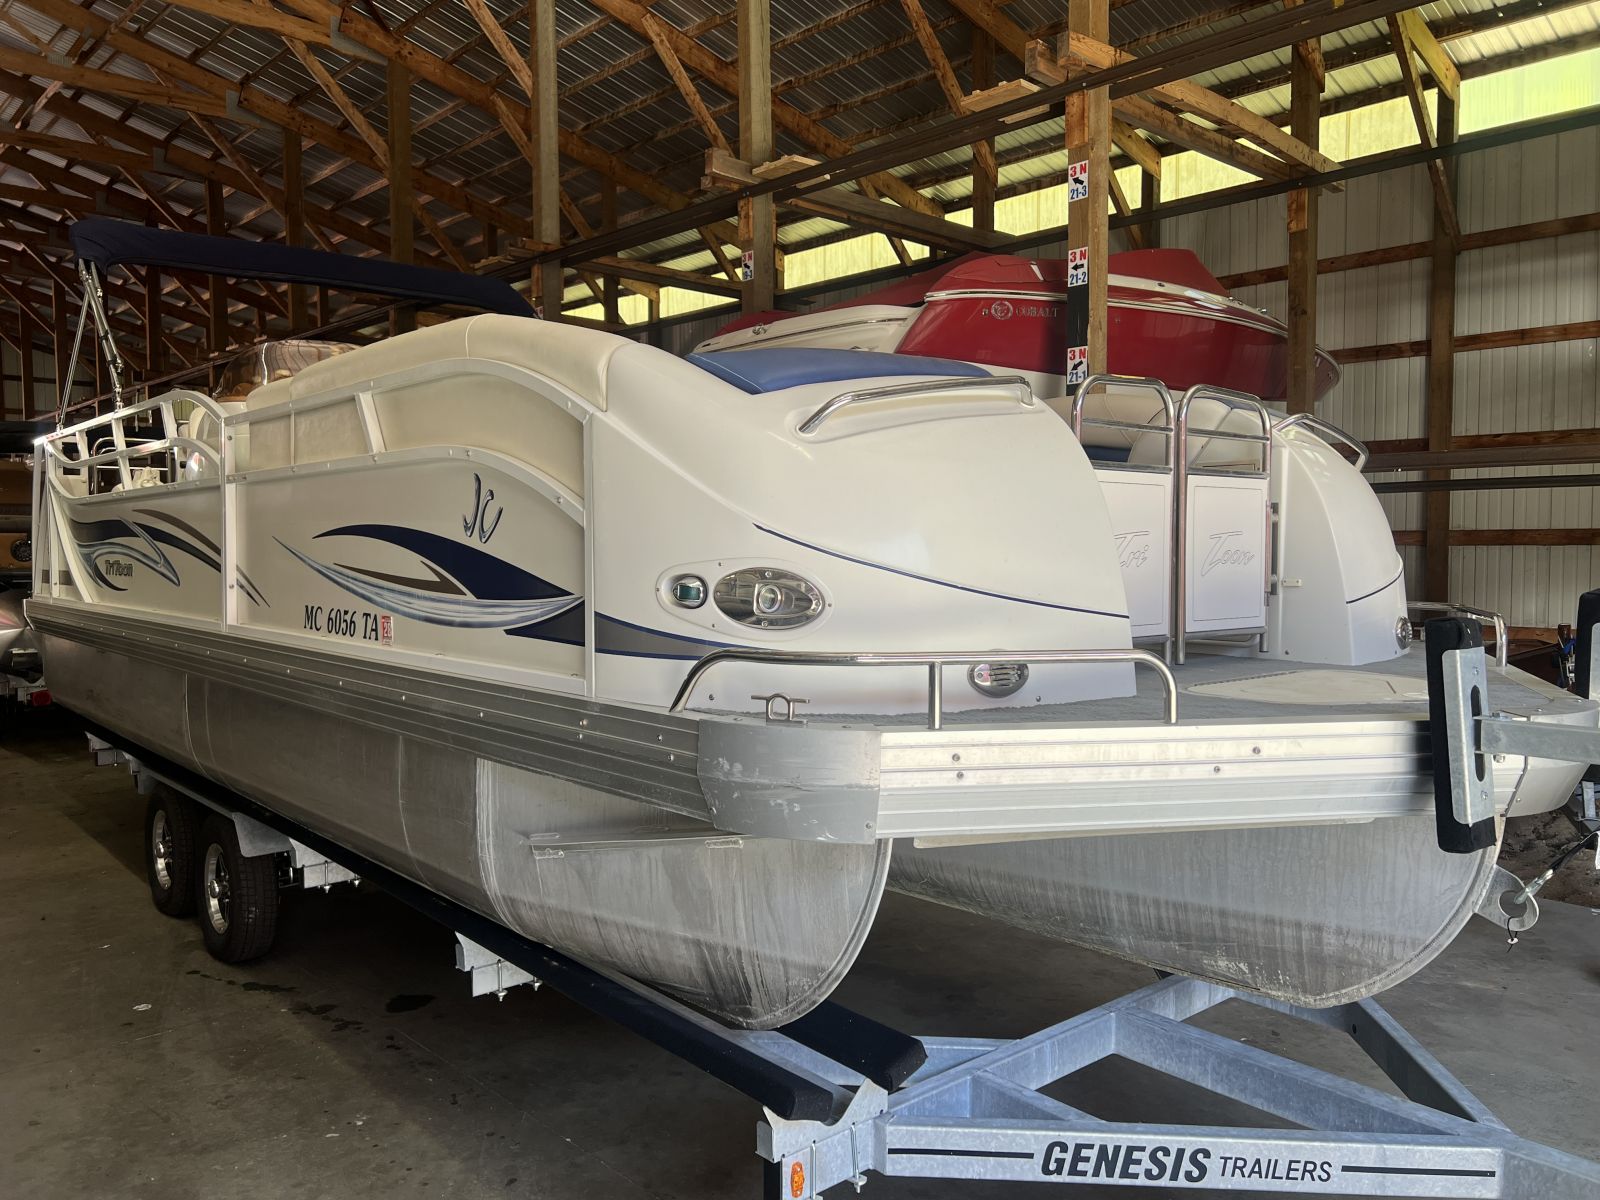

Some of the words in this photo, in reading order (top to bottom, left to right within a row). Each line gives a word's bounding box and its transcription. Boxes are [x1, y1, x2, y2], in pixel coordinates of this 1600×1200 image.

[1070, 165, 1077, 178] 3
[1080, 162, 1087, 175] N
[1070, 185, 1087, 200] 21-3
[1070, 251, 1077, 263] 3
[1079, 249, 1087, 261] N
[1070, 271, 1087, 286] 21-2
[1069, 349, 1076, 361] 3
[1079, 347, 1087, 359] N
[1068, 370, 1086, 384] 21-1
[303, 604, 323, 632] MC
[327, 607, 357, 638] 6056
[362, 612, 379, 641] TA
[1040, 1140, 1212, 1184] GENESIS
[1218, 1156, 1333, 1183] TRAILERS
